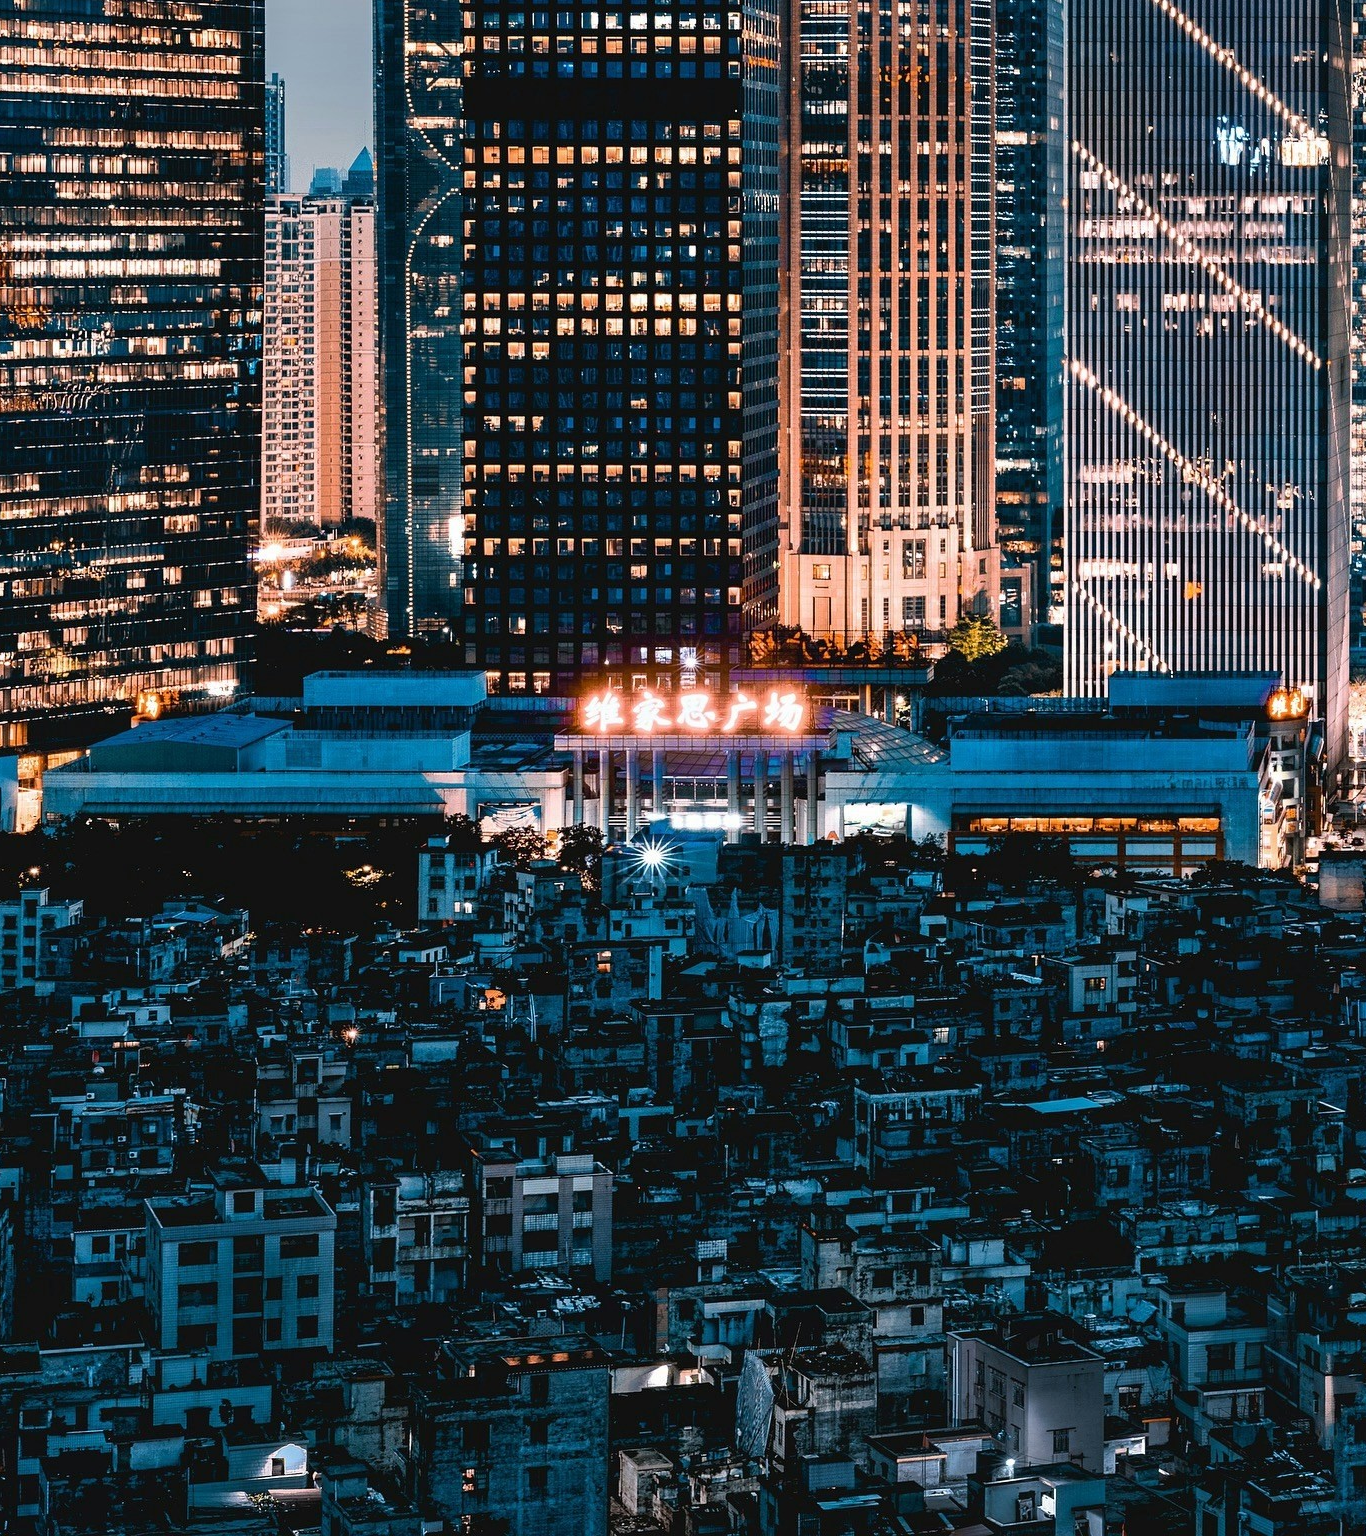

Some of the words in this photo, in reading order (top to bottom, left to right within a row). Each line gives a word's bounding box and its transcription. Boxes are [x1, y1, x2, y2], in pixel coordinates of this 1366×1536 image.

[584, 691, 805, 732] 维家思广场
